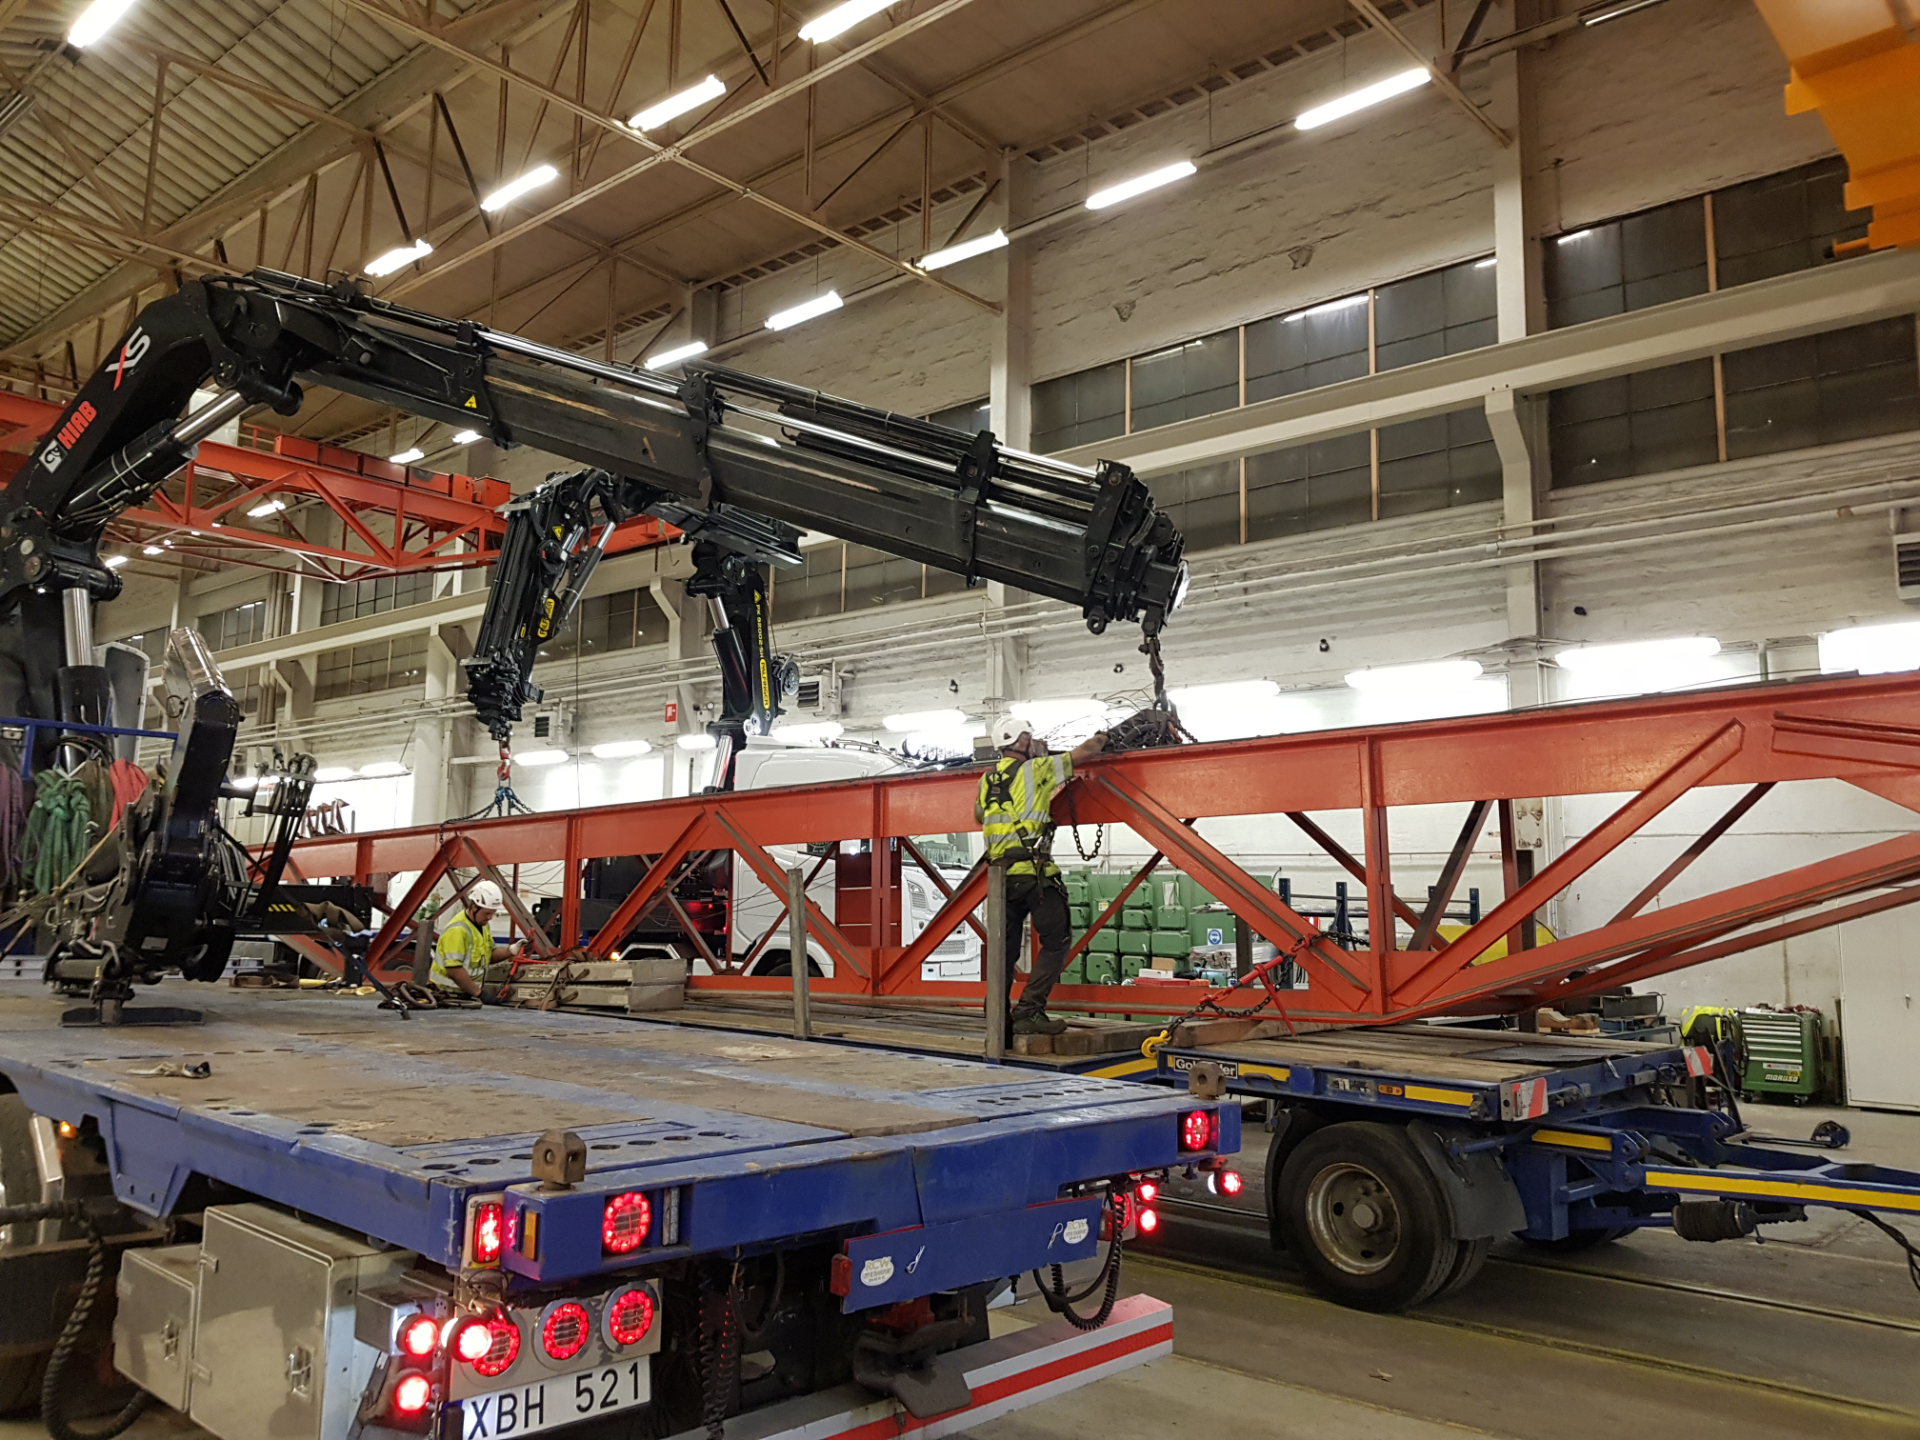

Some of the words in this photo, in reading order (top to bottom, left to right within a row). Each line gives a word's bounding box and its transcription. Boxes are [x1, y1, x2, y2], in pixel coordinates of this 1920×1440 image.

[105, 326, 151, 391] XS
[56, 400, 97, 450] HIAB
[755, 604, 761, 615] PK
[761, 662, 769, 706] PALFINGER
[866, 1259, 890, 1270] RCW
[469, 1385, 544, 1440] XBH
[576, 1361, 639, 1413] 521
